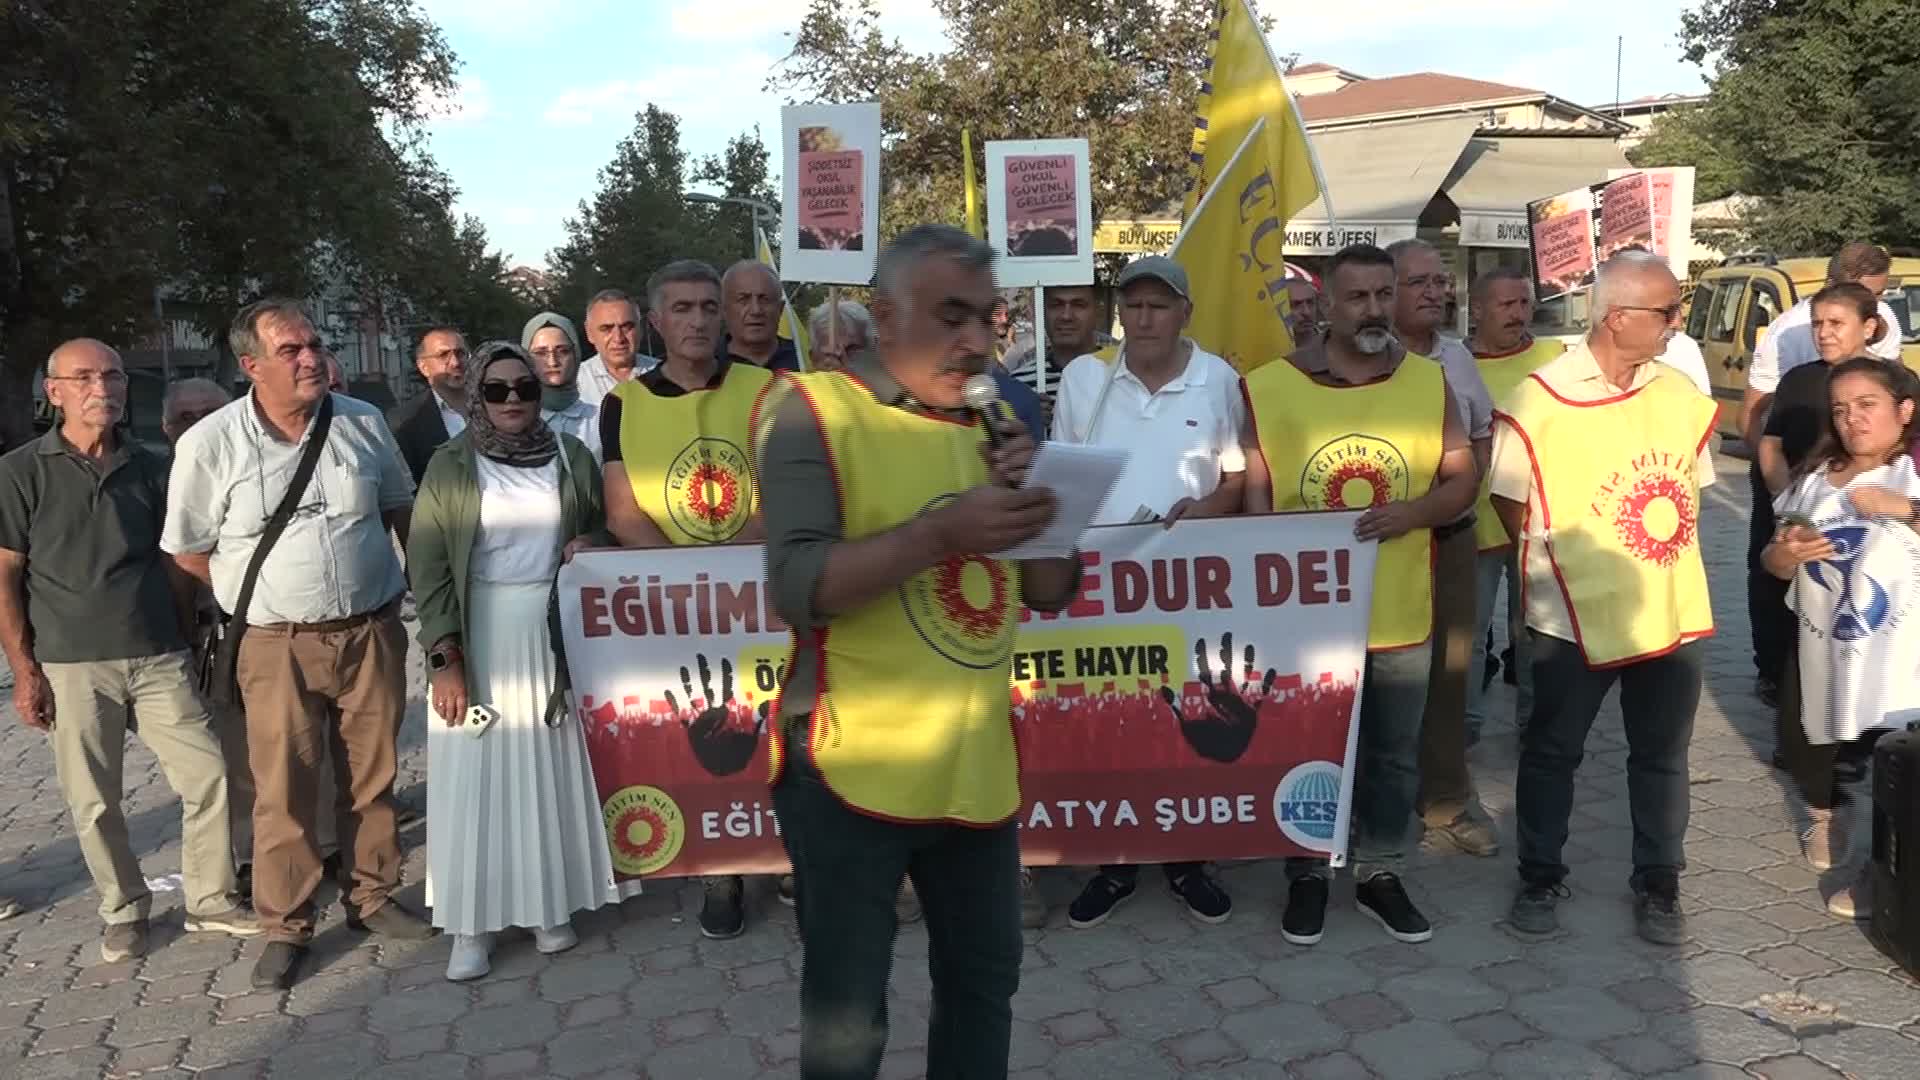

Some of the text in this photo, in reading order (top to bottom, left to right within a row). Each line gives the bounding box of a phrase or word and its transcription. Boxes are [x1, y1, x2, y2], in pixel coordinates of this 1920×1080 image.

[1022, 170, 1057, 183] OKUL
[807, 198, 849, 211] GELECEK
[1016, 191, 1075, 208] GELECEK
[1119, 228, 1177, 249] BÜYÜKŞE
[1284, 231, 1322, 247] KMEK
[719, 449, 746, 477] SEN
[1374, 448, 1403, 481] SEN
[1111, 556, 1233, 613] DUR
[1254, 549, 1352, 607] DE!
[1013, 649, 1065, 682] ETE
[1075, 644, 1169, 677] HAYIR
[701, 800, 783, 839] EĞİT
[1155, 794, 1257, 832] ŞUBE
[1280, 801, 1339, 822] KES
